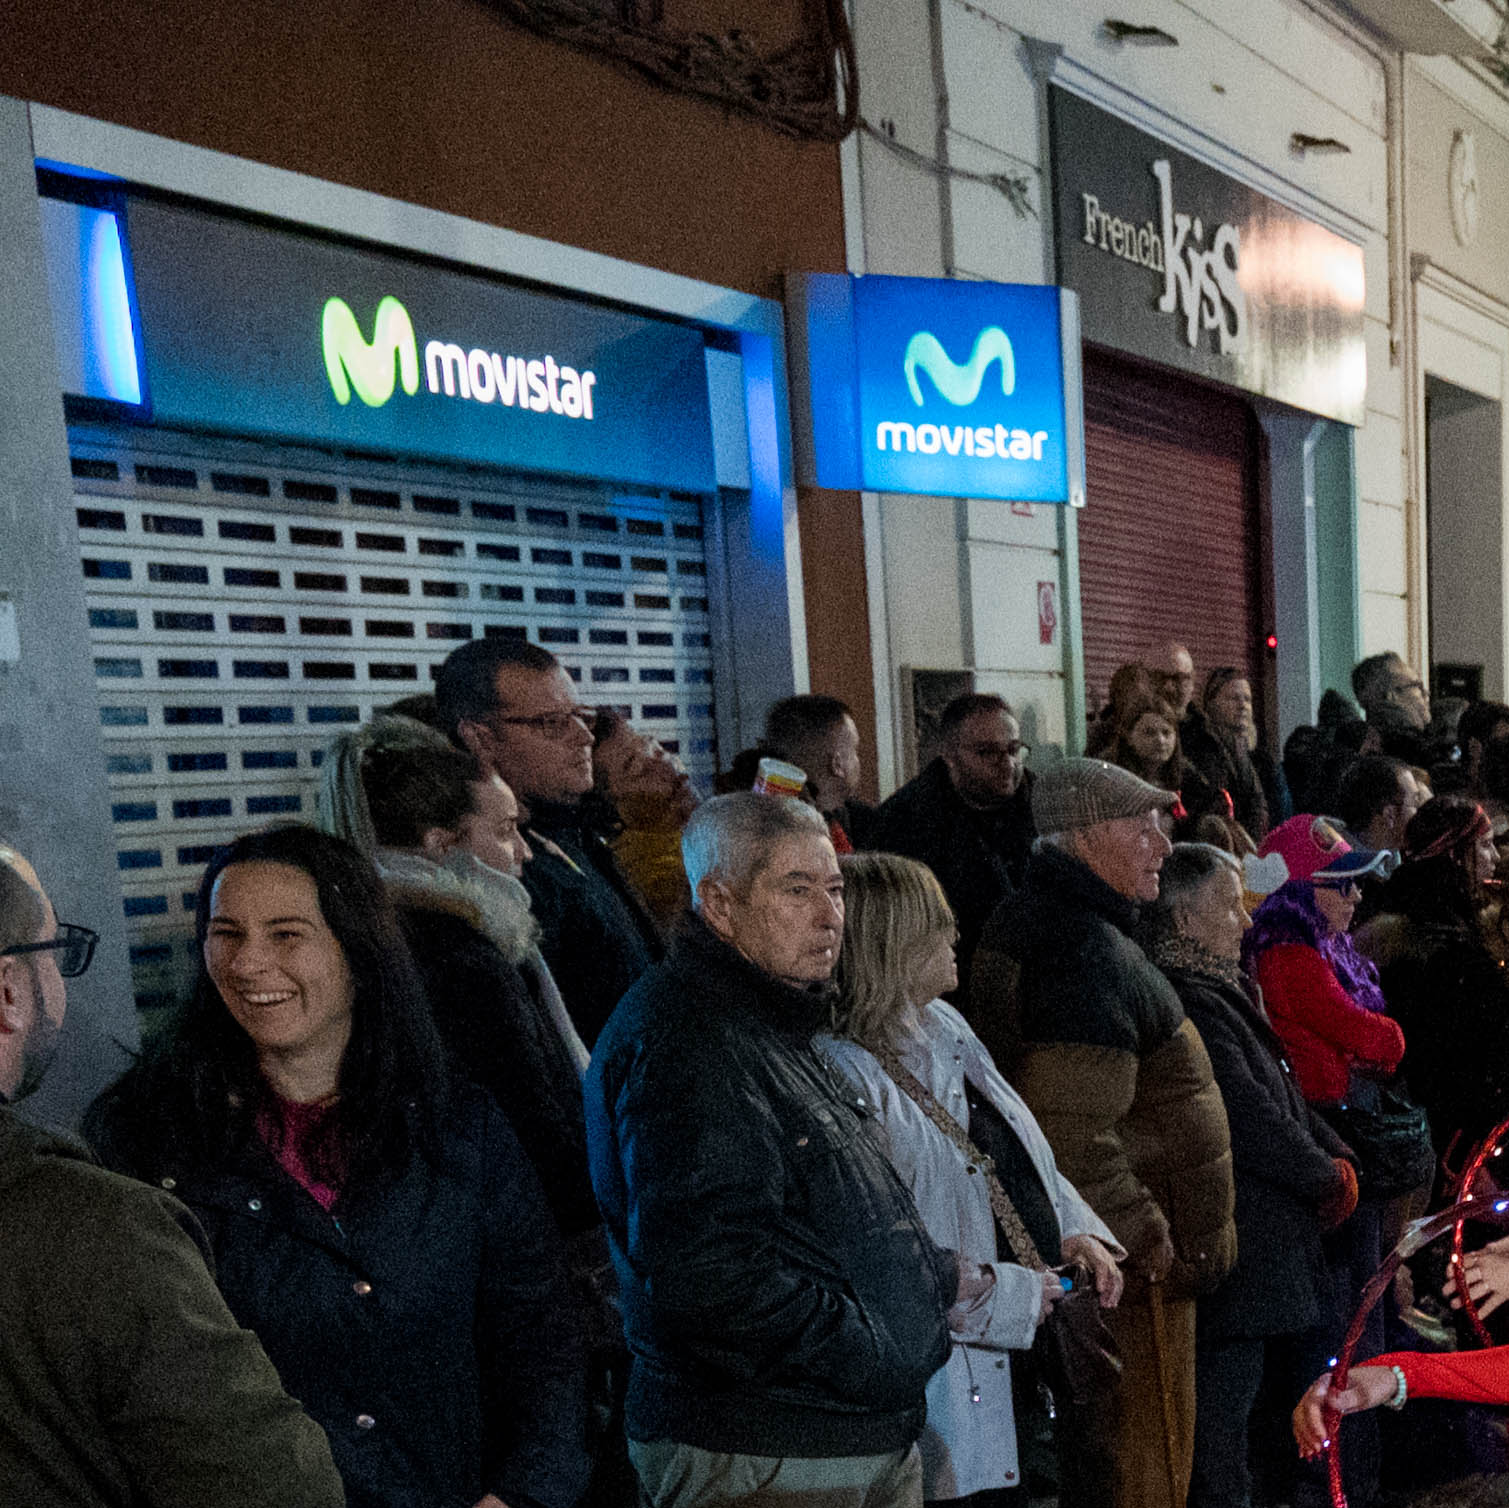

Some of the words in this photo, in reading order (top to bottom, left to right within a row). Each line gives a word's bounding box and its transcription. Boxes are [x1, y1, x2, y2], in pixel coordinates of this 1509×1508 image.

[1082, 193, 1165, 272] French
[424, 340, 596, 420] movistar
[877, 421, 1048, 461] movistar
